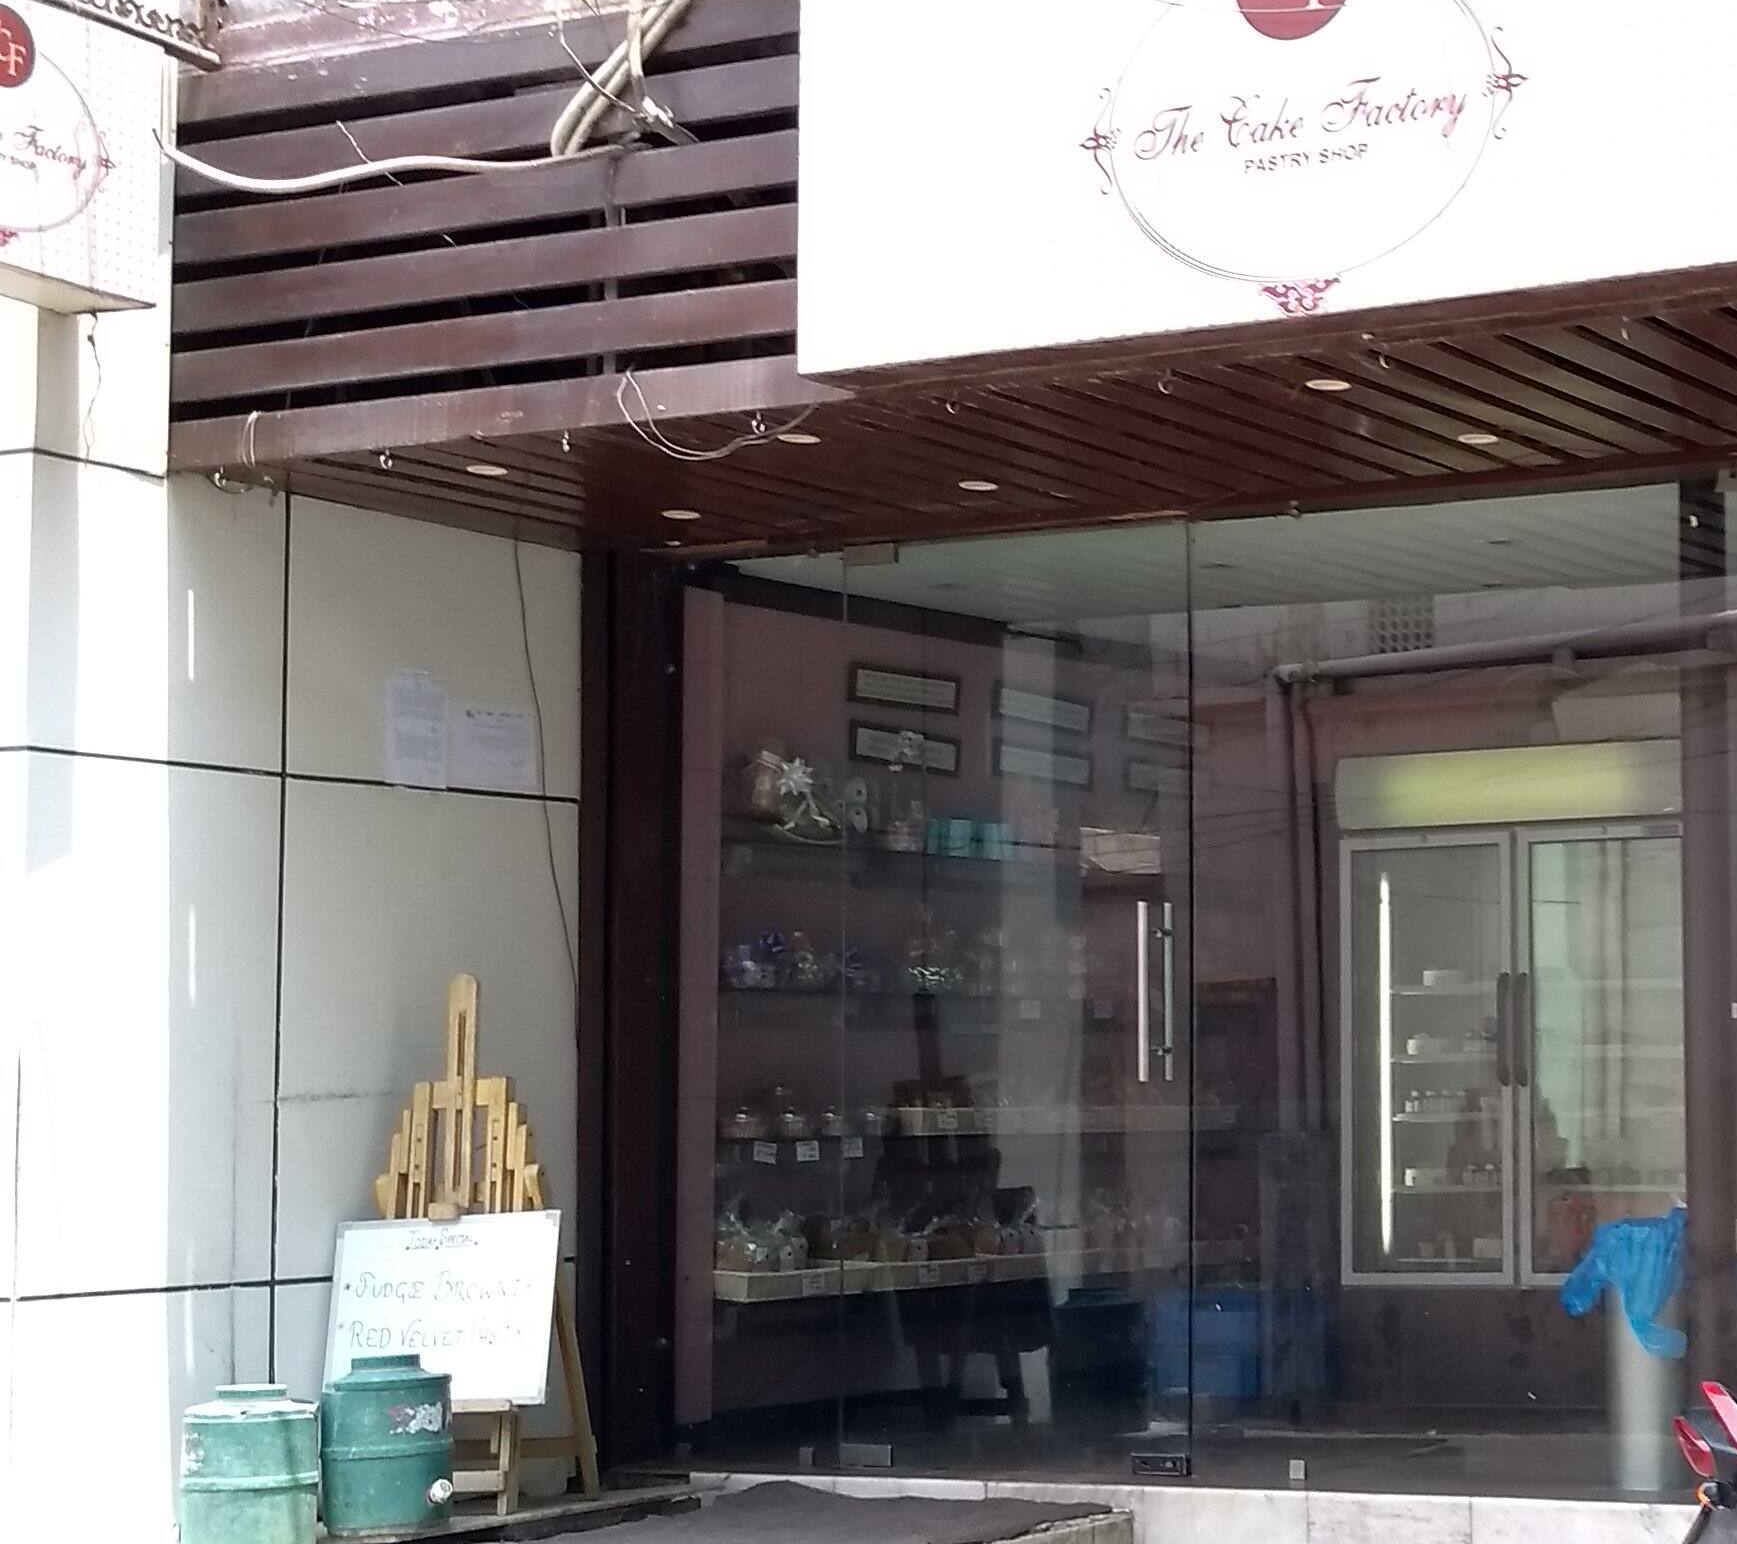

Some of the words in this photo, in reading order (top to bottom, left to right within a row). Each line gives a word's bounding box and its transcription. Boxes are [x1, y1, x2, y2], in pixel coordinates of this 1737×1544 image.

[1134, 106, 1204, 160] The
[1220, 95, 1303, 148] Cake
[1321, 77, 1466, 138] Factory
[1245, 152, 1312, 173] PASTRY
[1319, 143, 1368, 164] SHOP
[350, 1319, 392, 1348] RED
